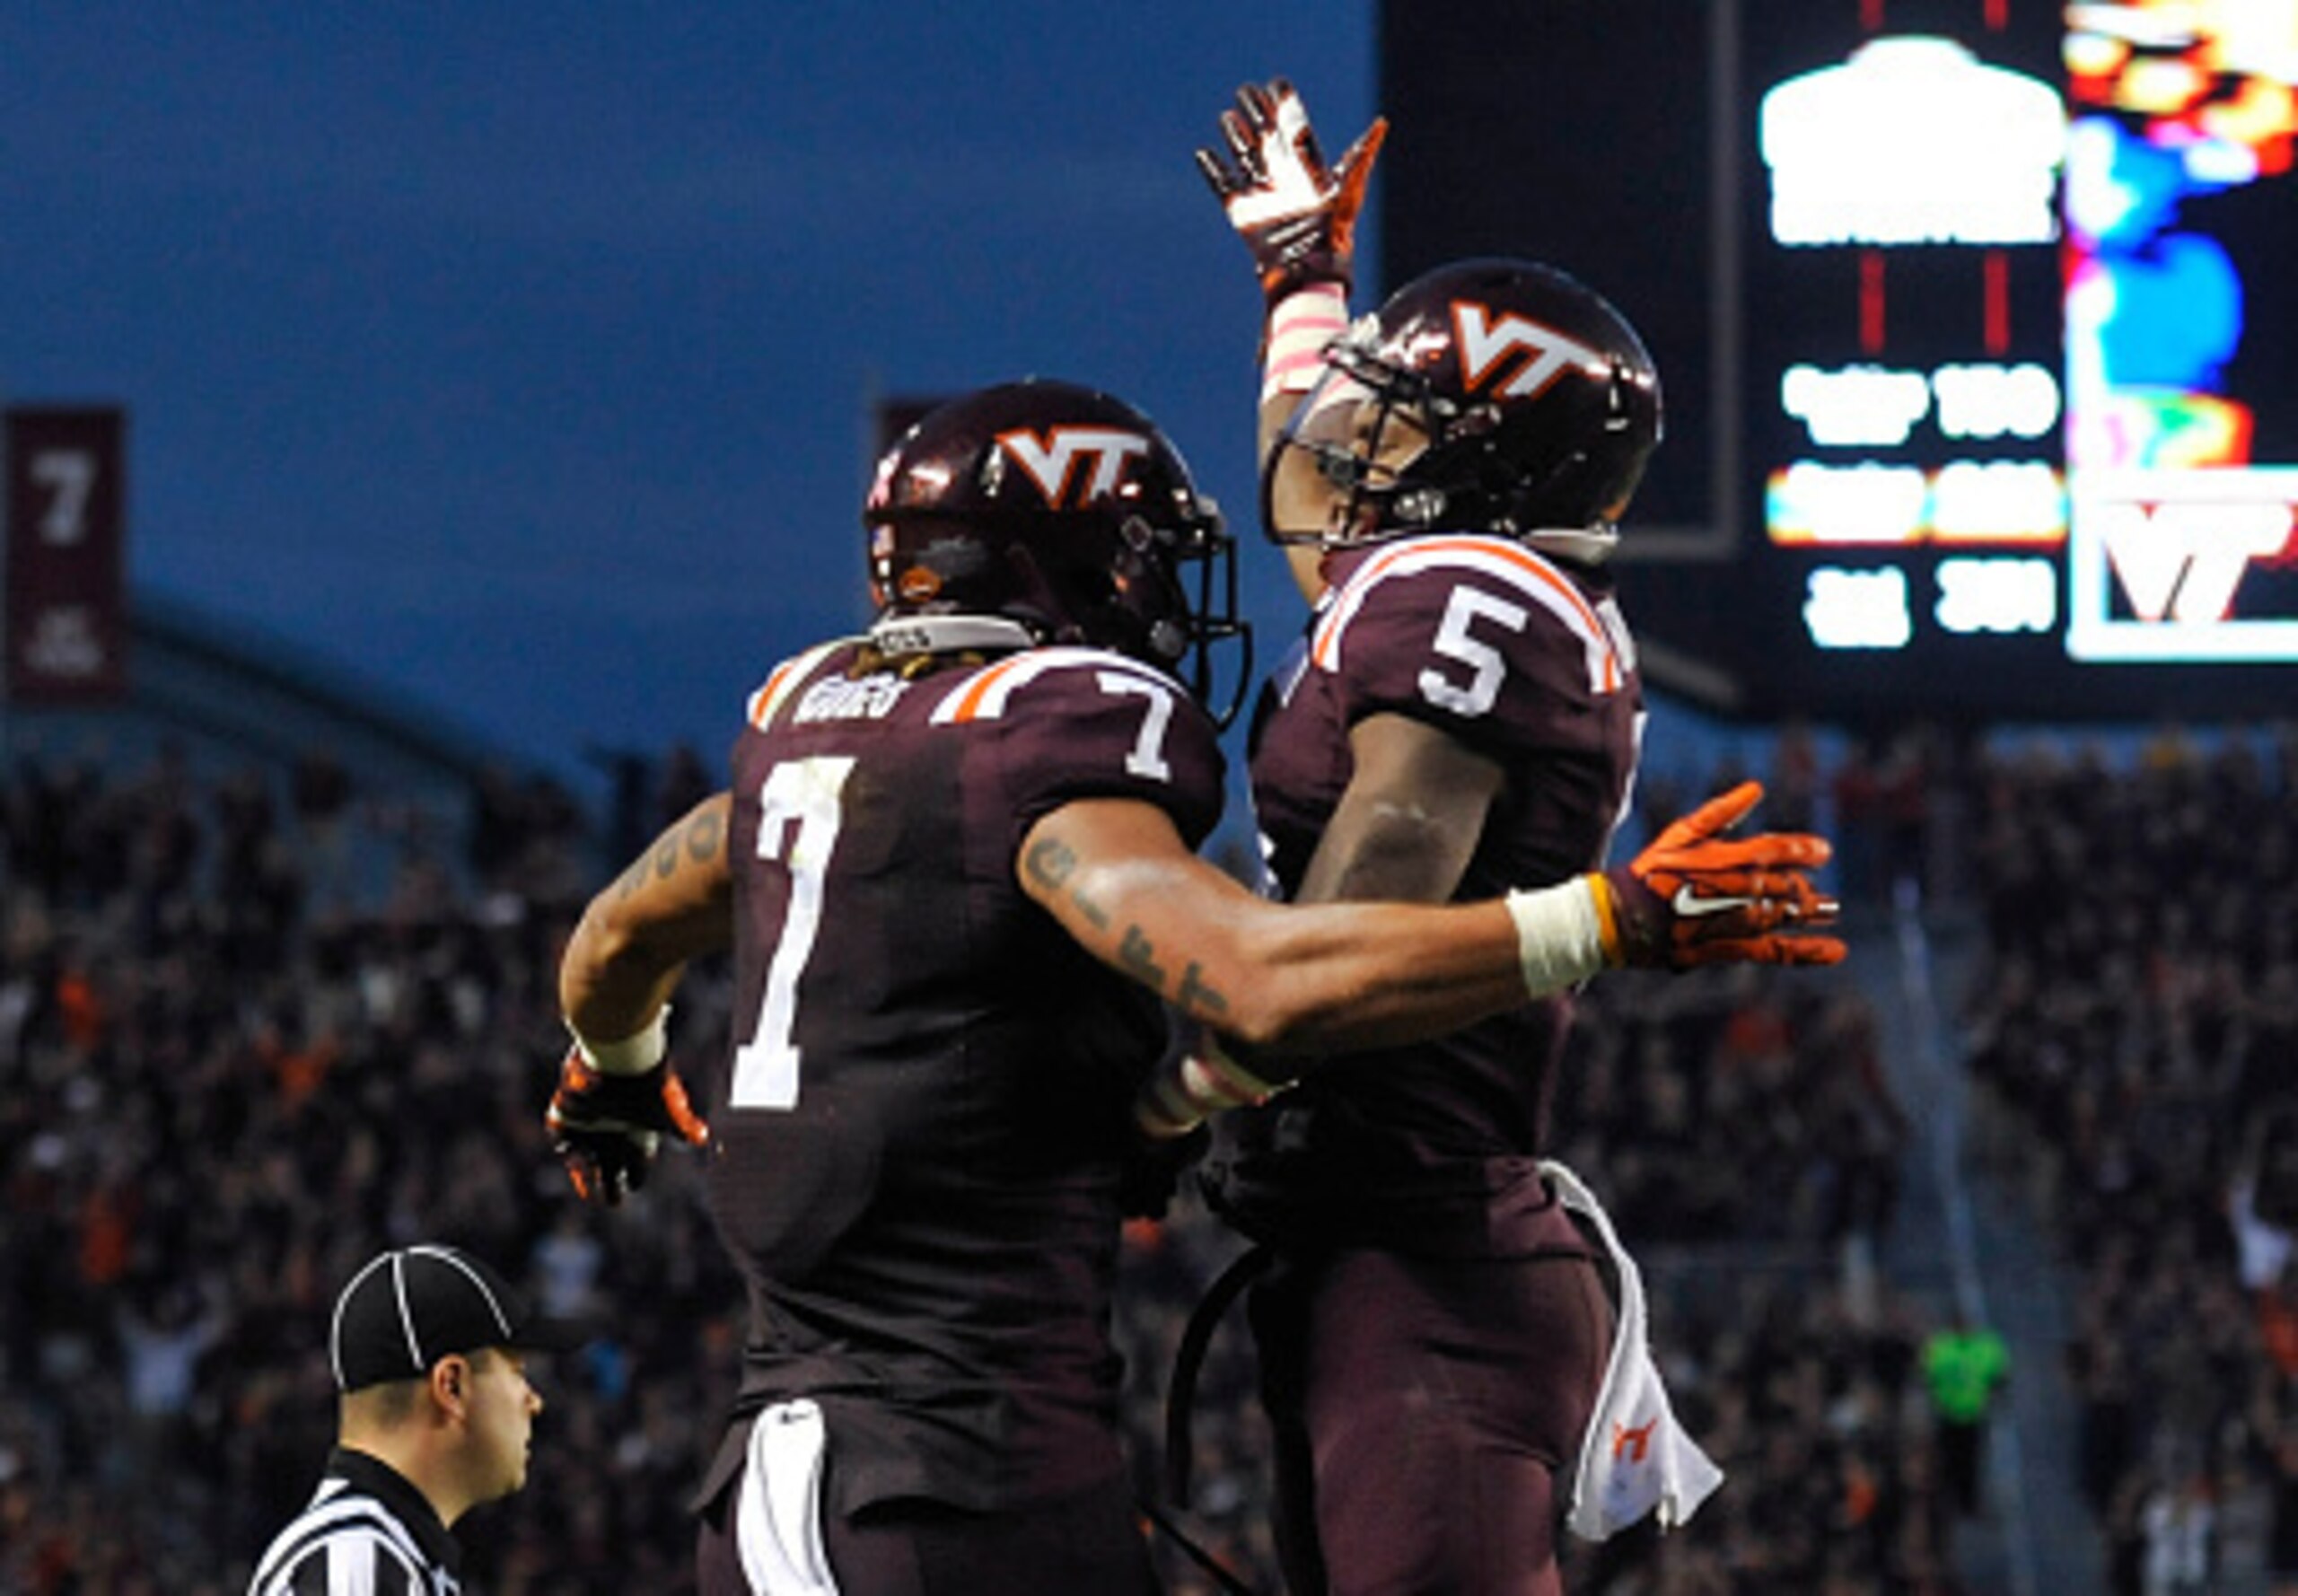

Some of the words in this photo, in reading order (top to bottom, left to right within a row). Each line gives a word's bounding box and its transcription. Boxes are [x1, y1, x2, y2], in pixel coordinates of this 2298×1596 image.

[1451, 299, 1610, 400] VT
[30, 451, 97, 545] 7
[995, 424, 1150, 510] VT
[1418, 584, 1529, 716] 5
[1096, 671, 1172, 783] 7
[730, 756, 857, 1109] 7
